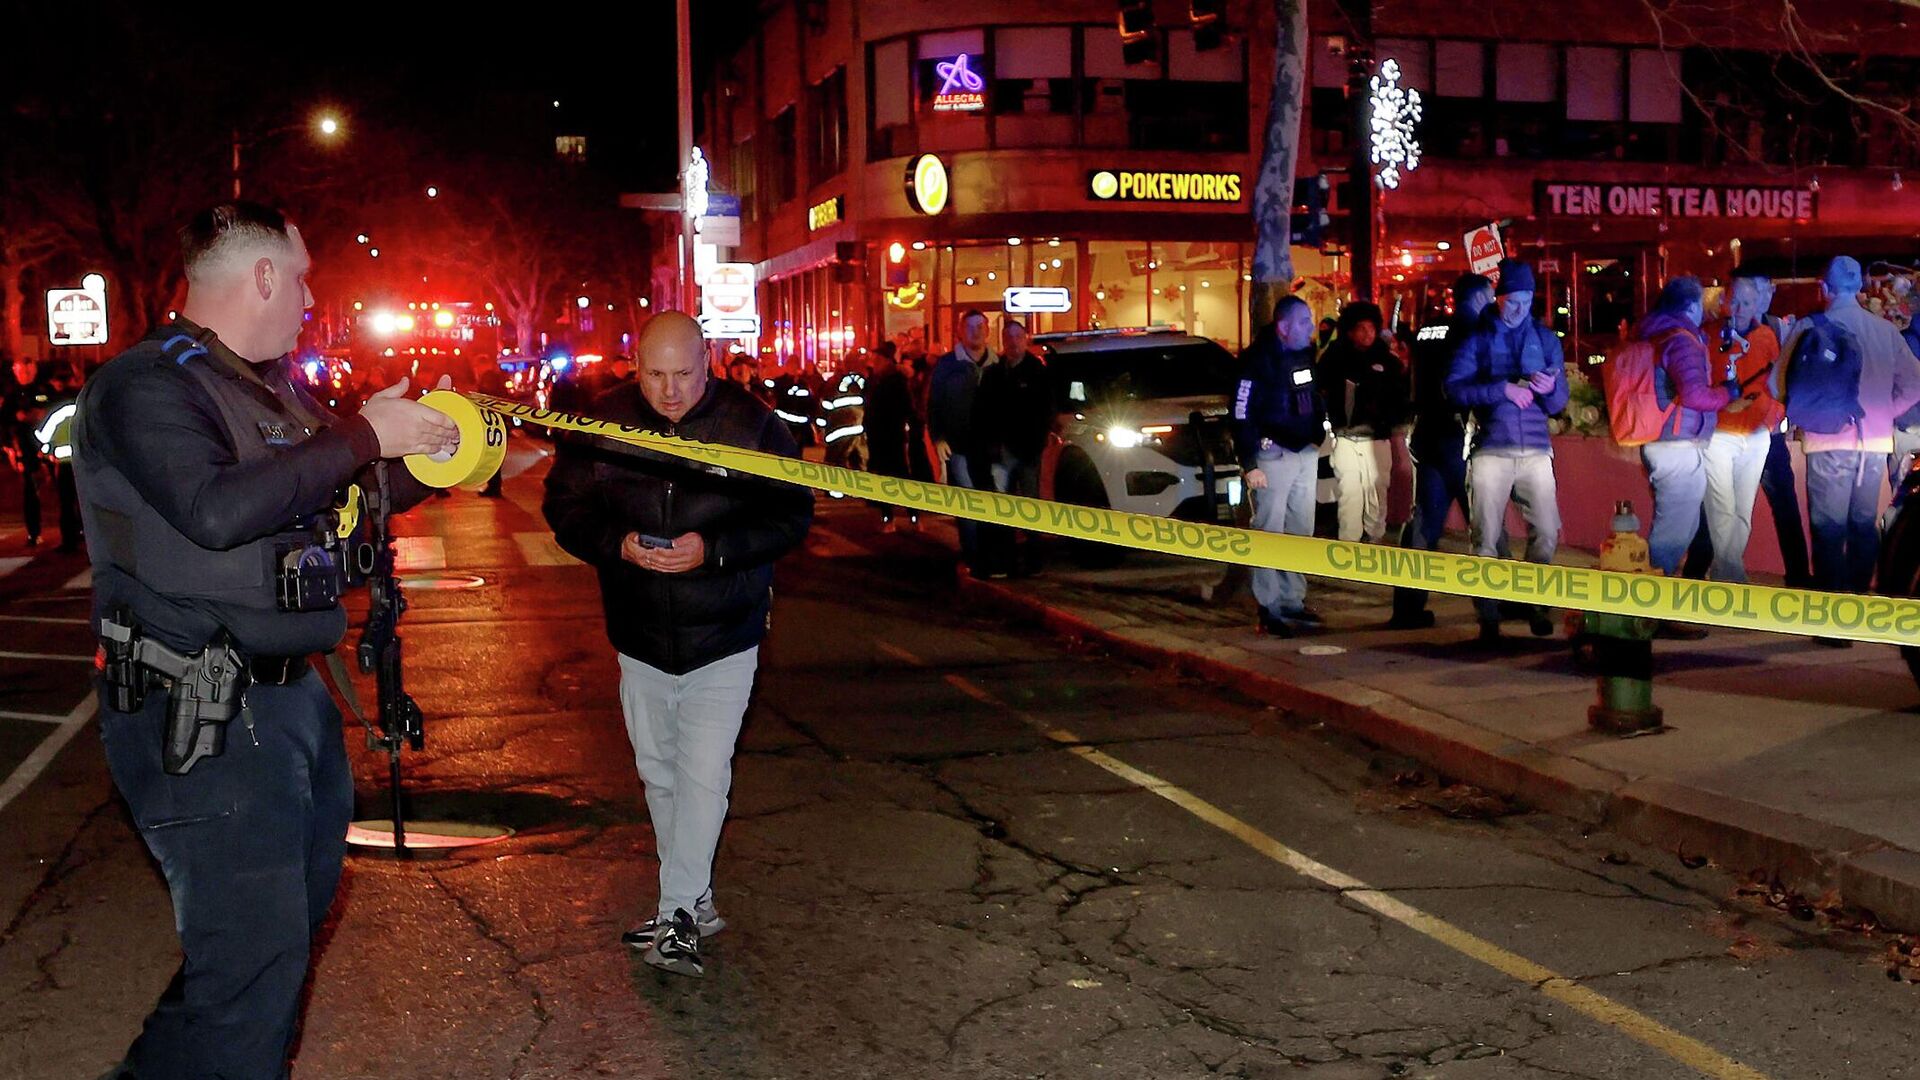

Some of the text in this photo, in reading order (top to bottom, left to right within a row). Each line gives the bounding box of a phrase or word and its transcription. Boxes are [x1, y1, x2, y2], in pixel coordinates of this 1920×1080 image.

[934, 94, 983, 104] ALLEGRA
[1119, 172, 1241, 200] POKEWORKS
[1547, 185, 1813, 219] TEN ONE TEA HOUSE
[1472, 239, 1497, 257] DO NOT
